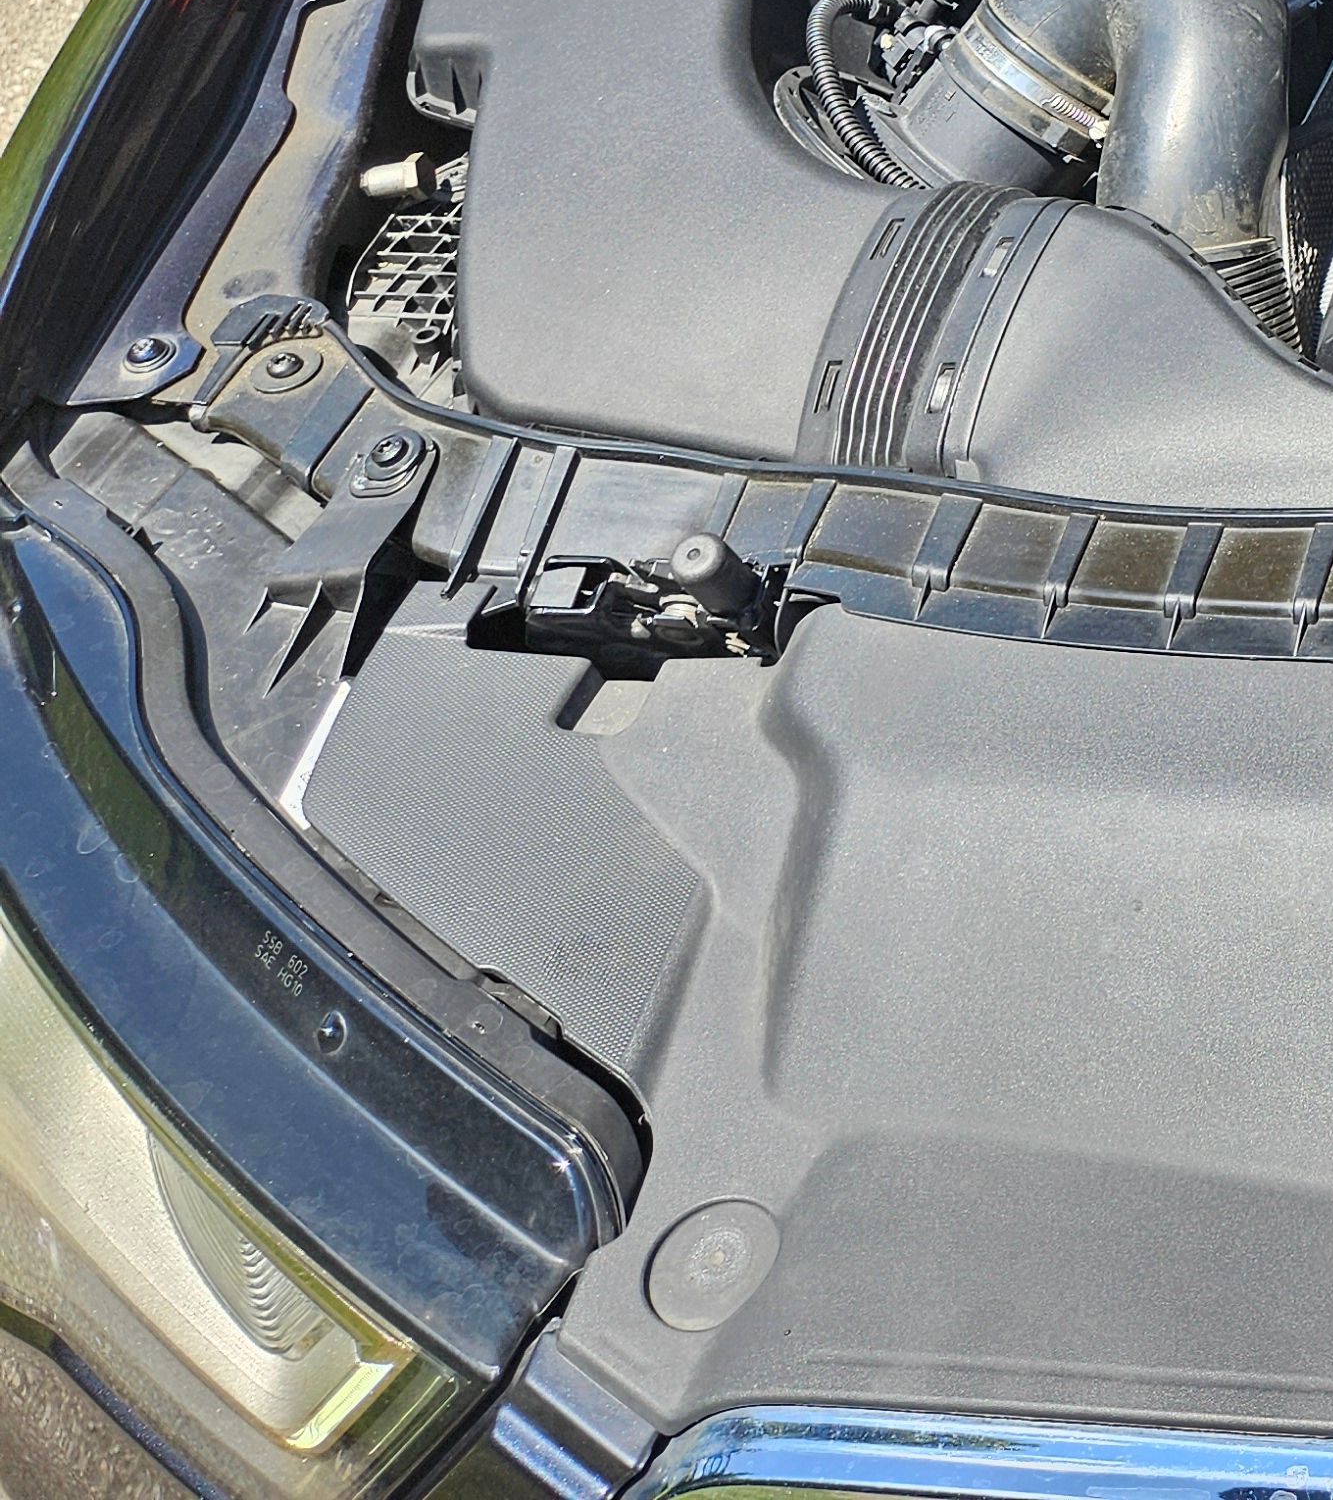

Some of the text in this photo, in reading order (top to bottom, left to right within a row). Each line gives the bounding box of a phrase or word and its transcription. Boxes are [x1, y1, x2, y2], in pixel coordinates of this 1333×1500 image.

[255, 944, 303, 997] SAE HG10
[262, 930, 308, 979] SSB 602
